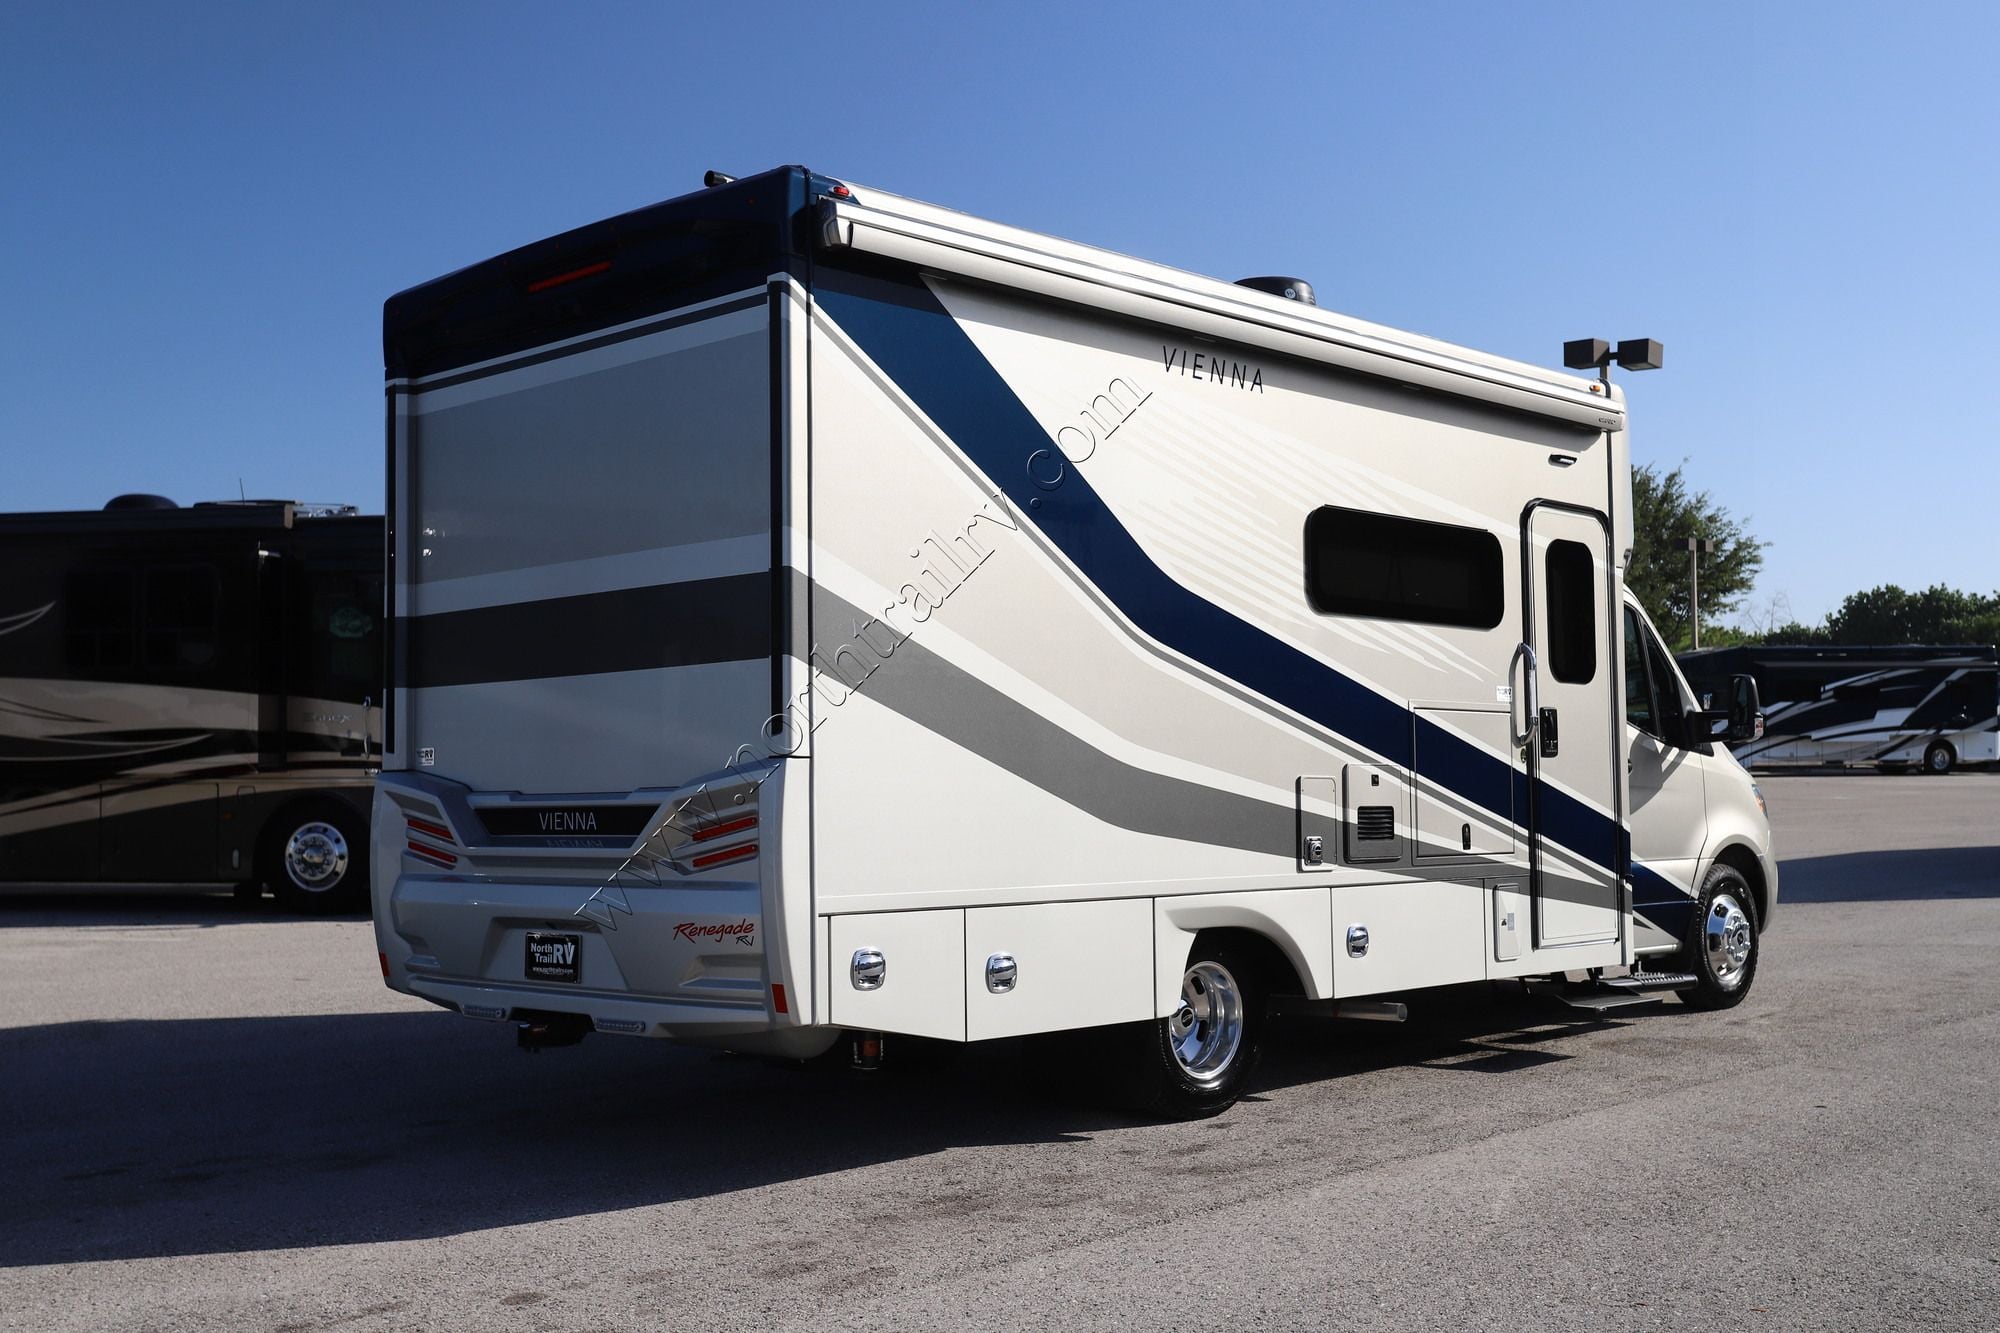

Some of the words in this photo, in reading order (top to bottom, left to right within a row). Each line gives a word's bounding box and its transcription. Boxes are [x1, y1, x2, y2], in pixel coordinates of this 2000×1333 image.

[1162, 344, 1264, 395] VIENNA
[539, 811, 597, 831] VIENNA
[672, 918, 754, 944] Renegade
[735, 935, 754, 947] RV
[530, 942, 553, 953] North
[553, 942, 576, 965] RV
[534, 953, 553, 964] Trail
